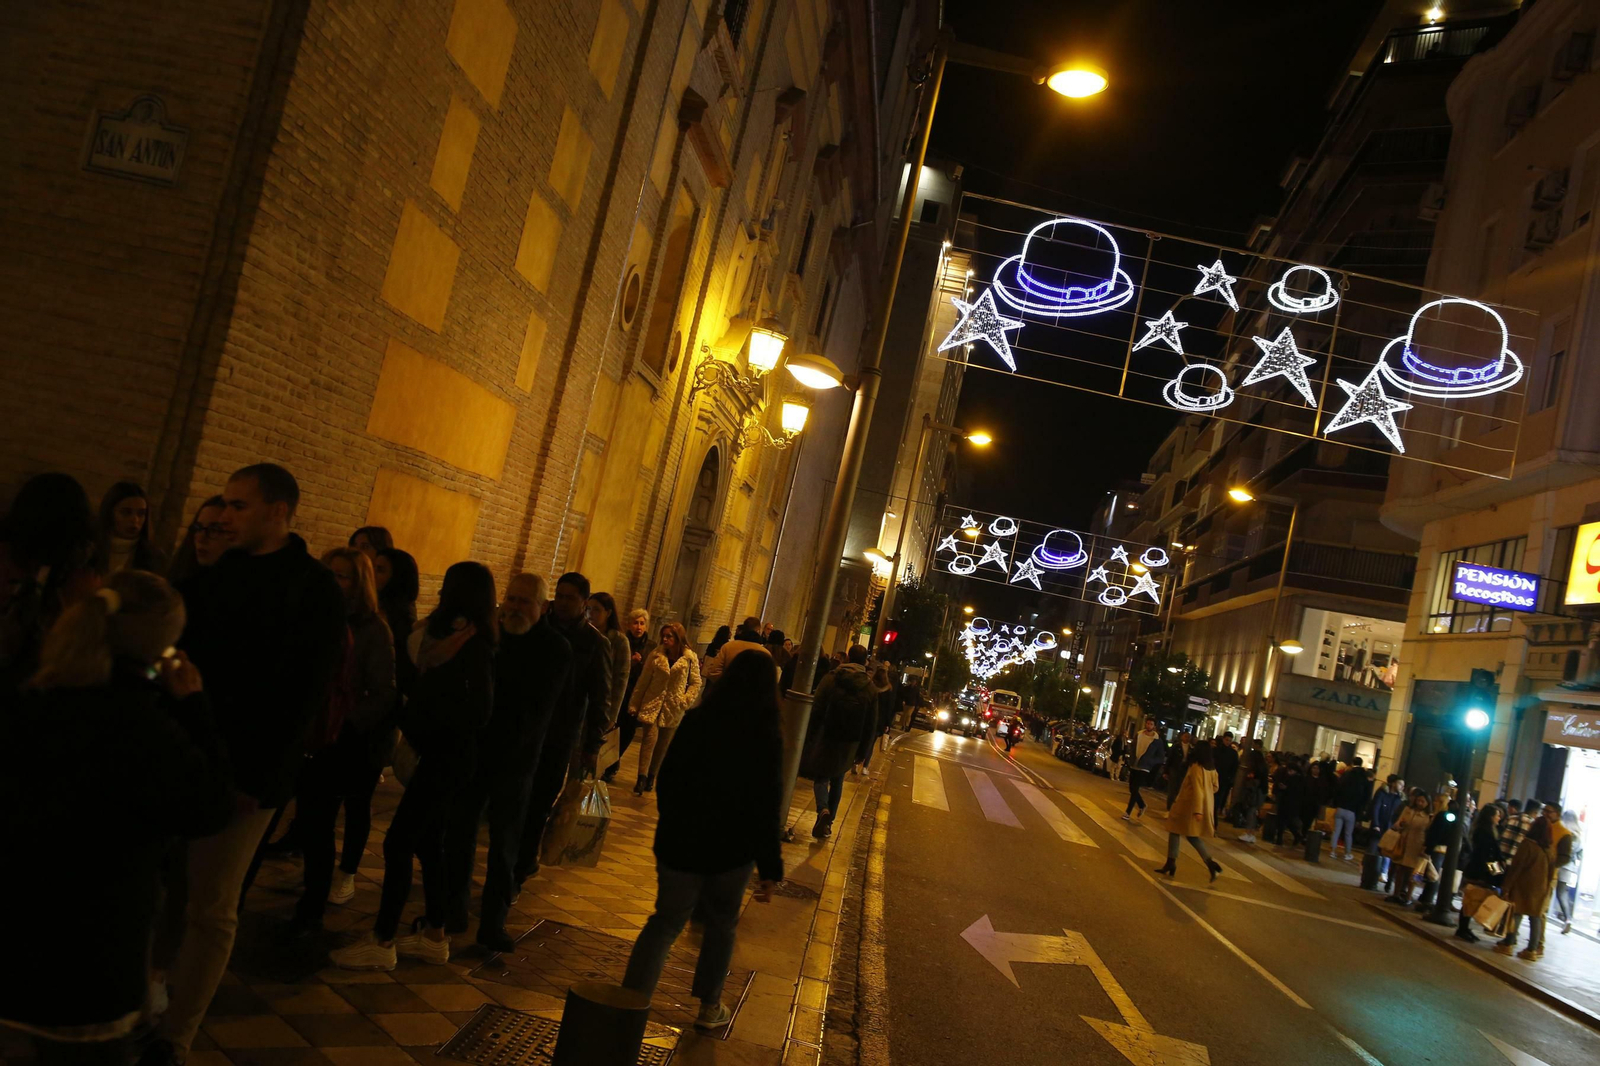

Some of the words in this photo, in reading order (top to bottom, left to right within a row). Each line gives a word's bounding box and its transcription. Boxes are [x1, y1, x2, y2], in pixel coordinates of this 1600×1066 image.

[95, 129, 129, 159] SAN
[1457, 567, 1536, 591] PENSIÓN
[1455, 582, 1534, 606] Recogidas
[1070, 621, 1084, 664] UNVERSAL
[1312, 687, 1380, 711] ZARA
